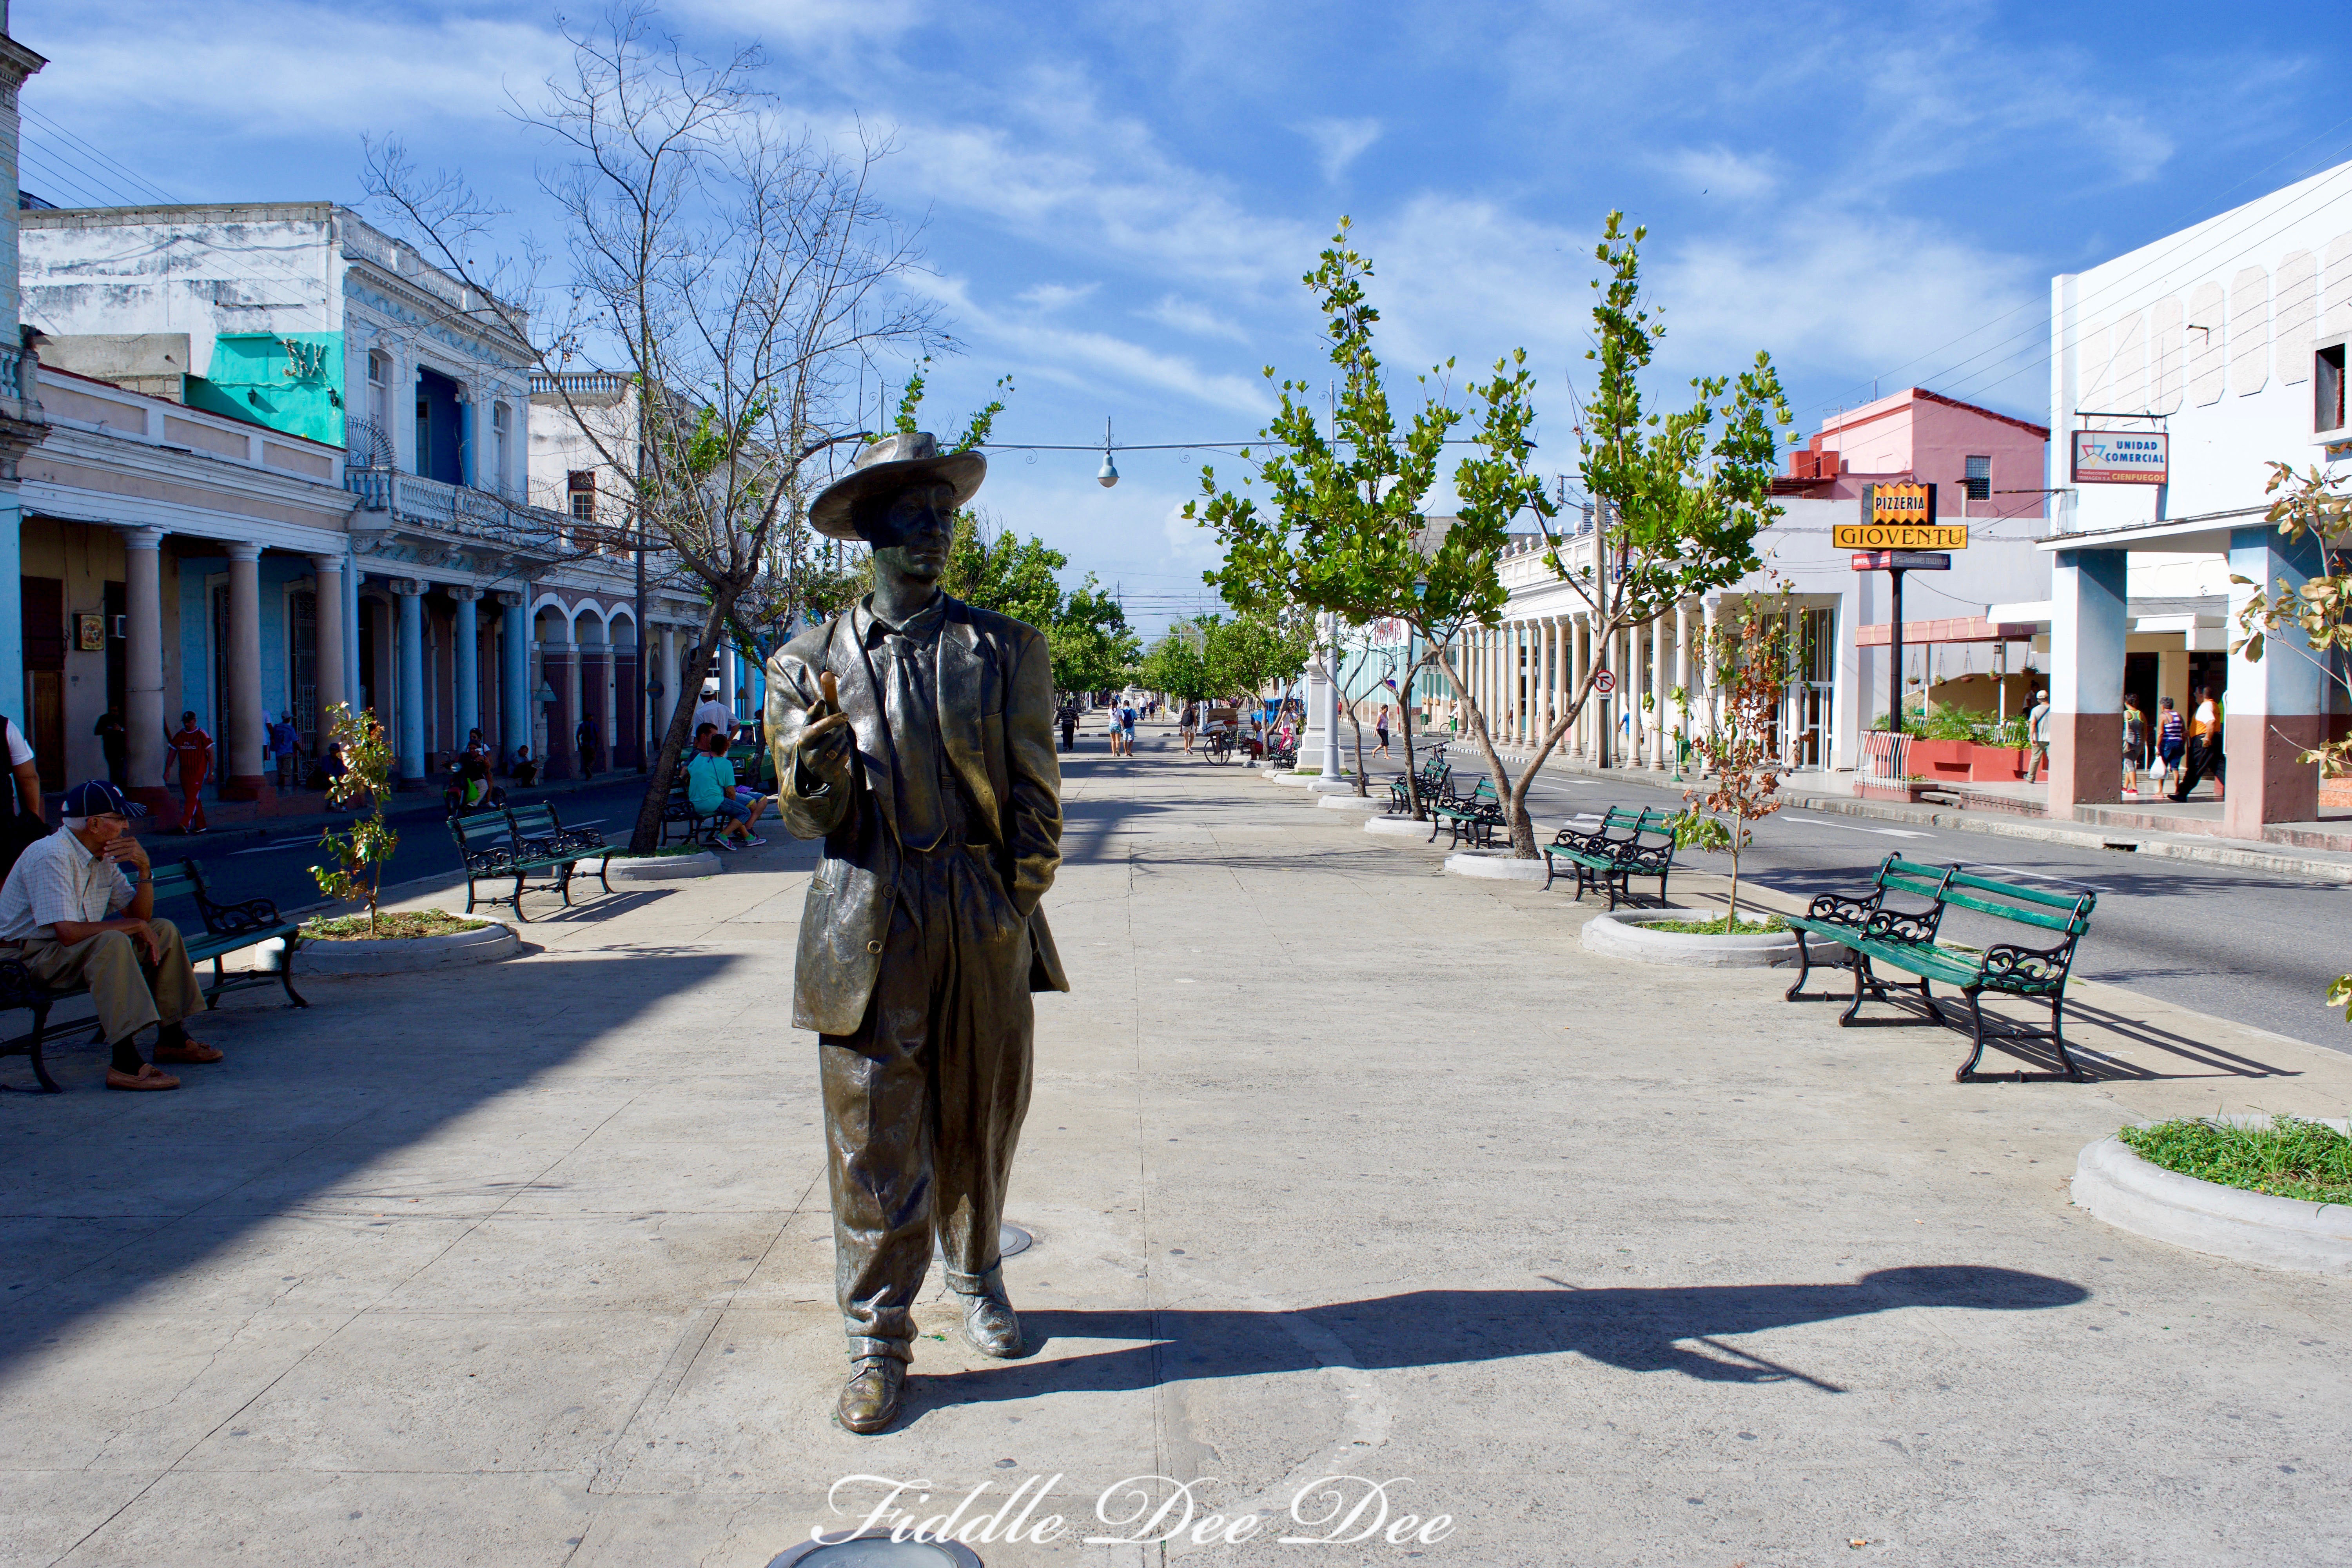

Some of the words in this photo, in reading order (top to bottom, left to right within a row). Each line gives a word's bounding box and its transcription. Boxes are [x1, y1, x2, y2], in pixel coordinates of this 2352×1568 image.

[2116, 441, 2157, 450] UNIDAD
[2105, 453, 2164, 463] COMERCIAL
[1876, 497, 1924, 510] PIZZERIA
[1841, 528, 1963, 544] GIOVENTU
